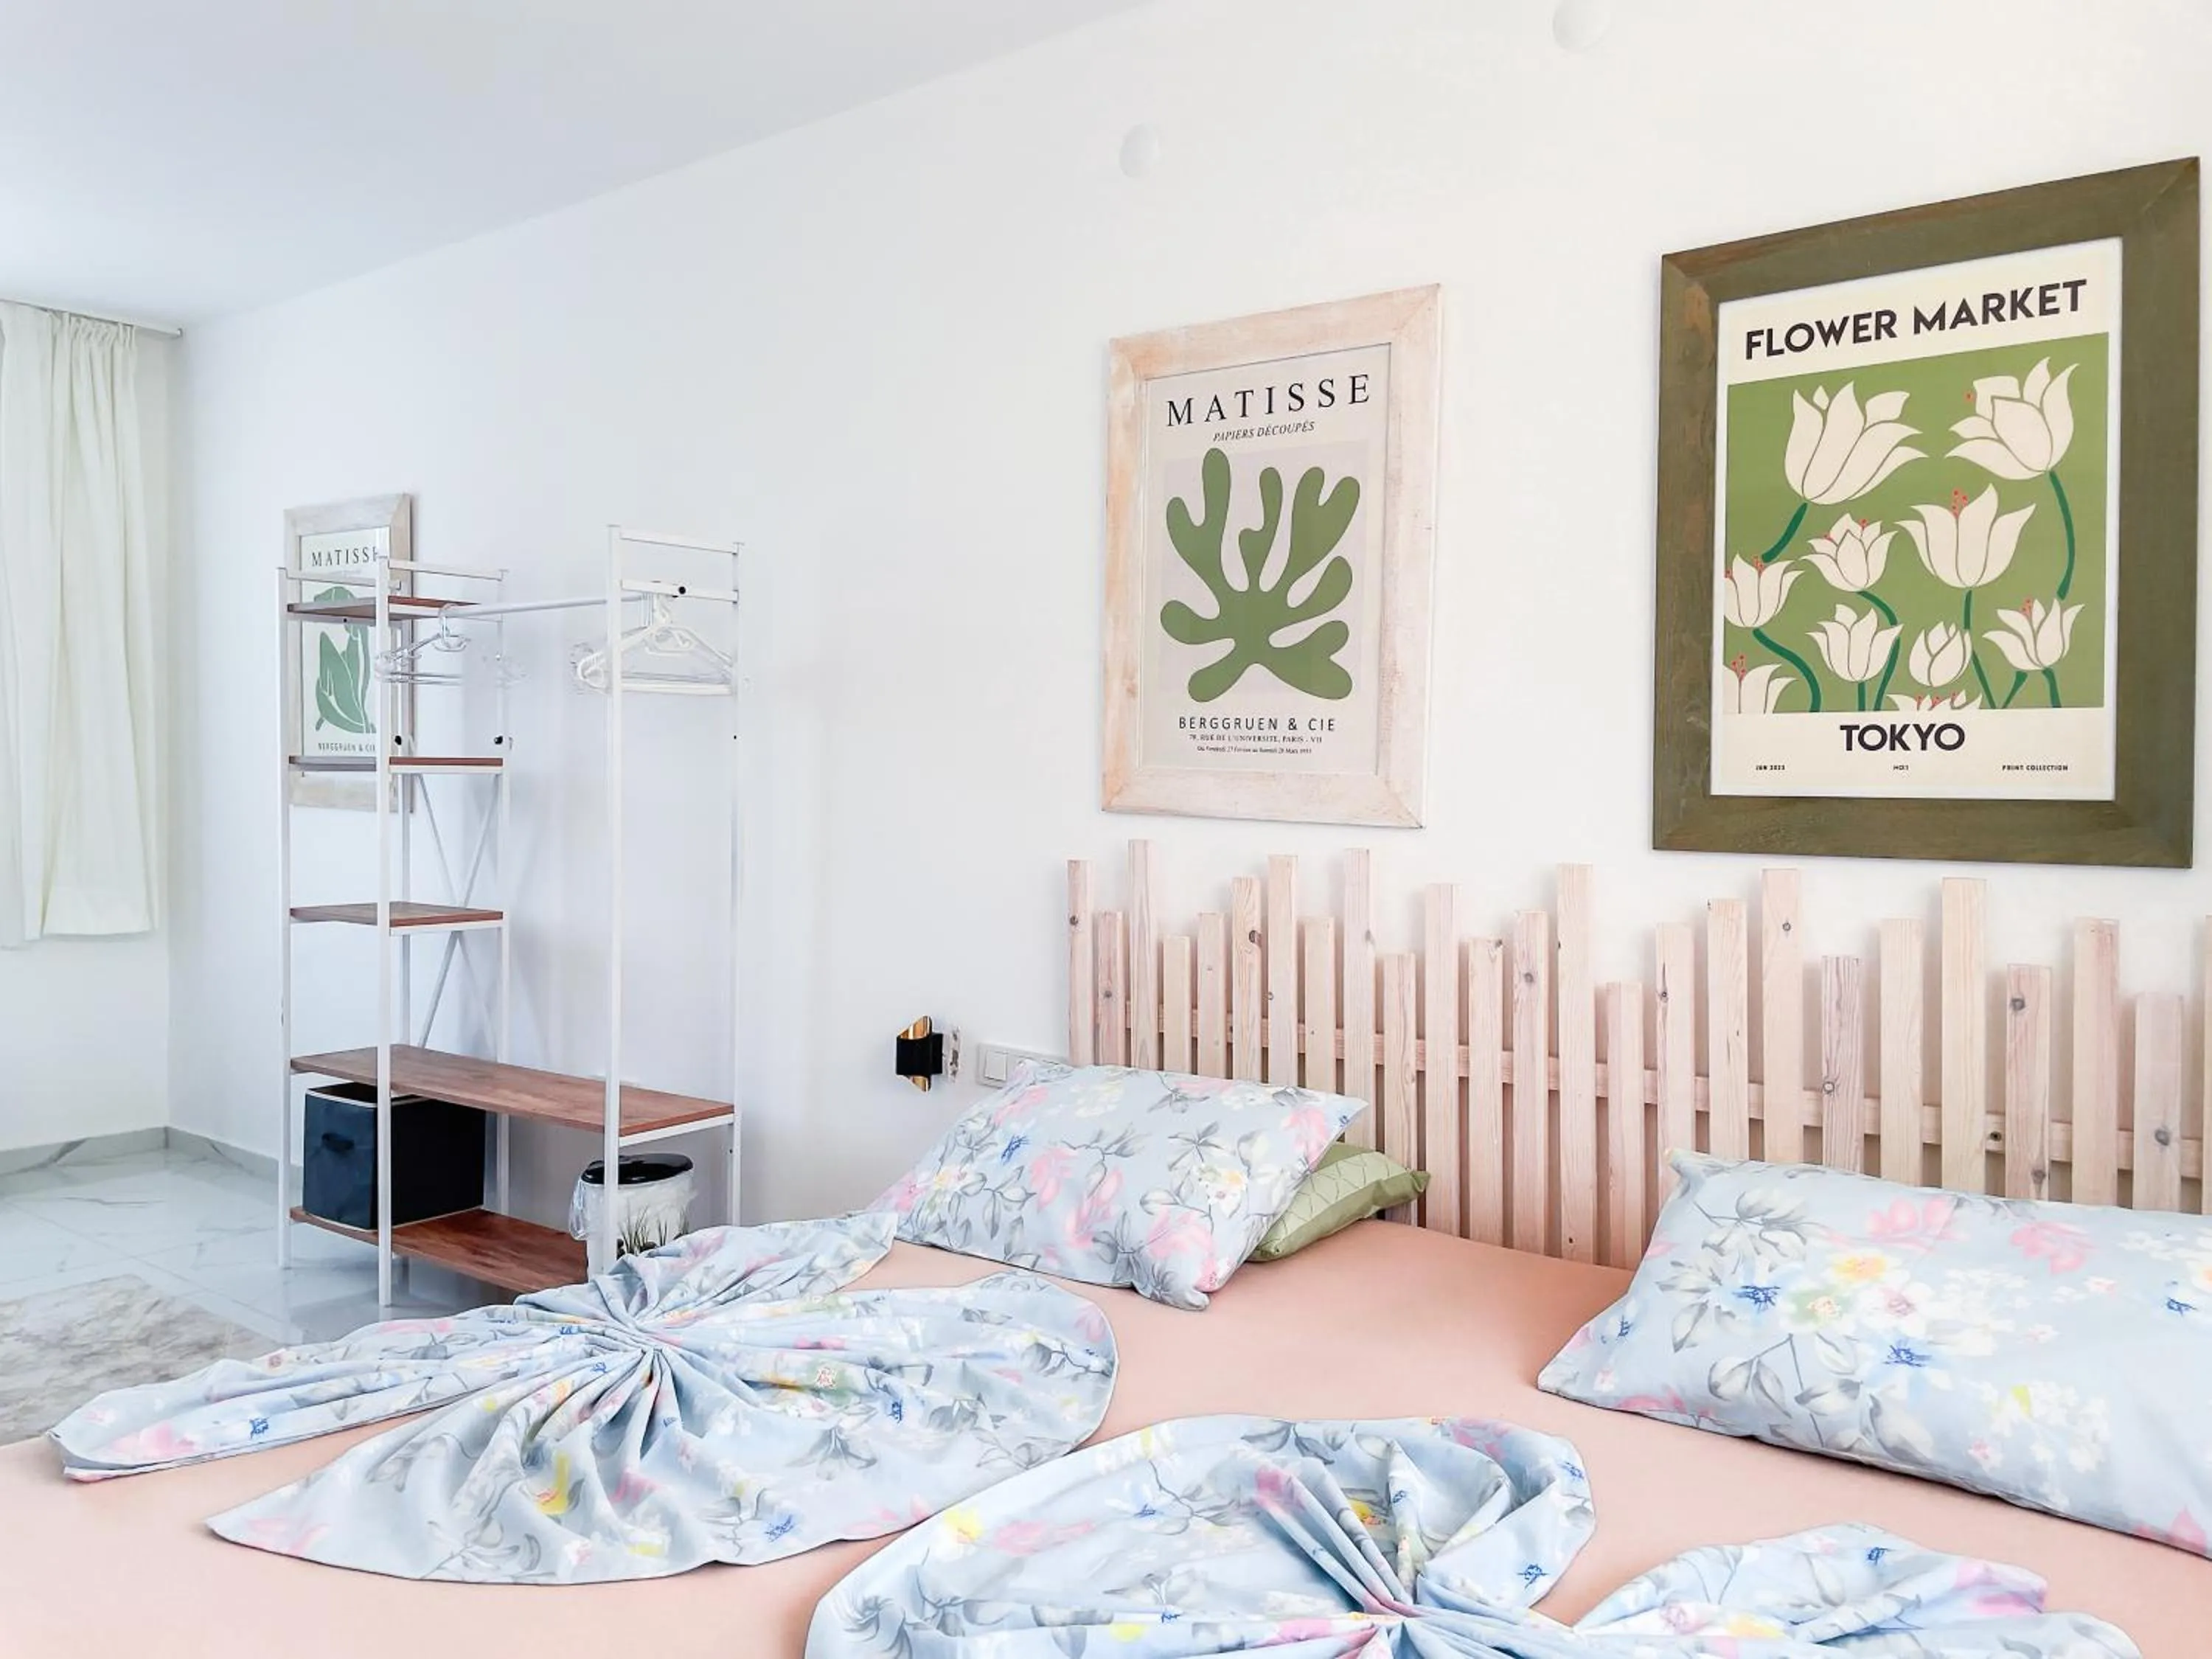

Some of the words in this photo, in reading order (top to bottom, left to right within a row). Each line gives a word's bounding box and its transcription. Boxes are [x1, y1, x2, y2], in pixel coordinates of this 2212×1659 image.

[1745, 309, 1898, 361] FLOWER
[1913, 279, 2087, 335] MARKET
[1166, 374, 1371, 427] MATISSE
[1213, 426, 1254, 442] PAPIERS
[1256, 419, 1316, 438] DÉCOUPÉS
[1178, 716, 1279, 731] BERGGRUEN
[1287, 717, 1298, 731] &
[1307, 718, 1337, 731] CIE
[1840, 723, 1966, 751] TOKYO
